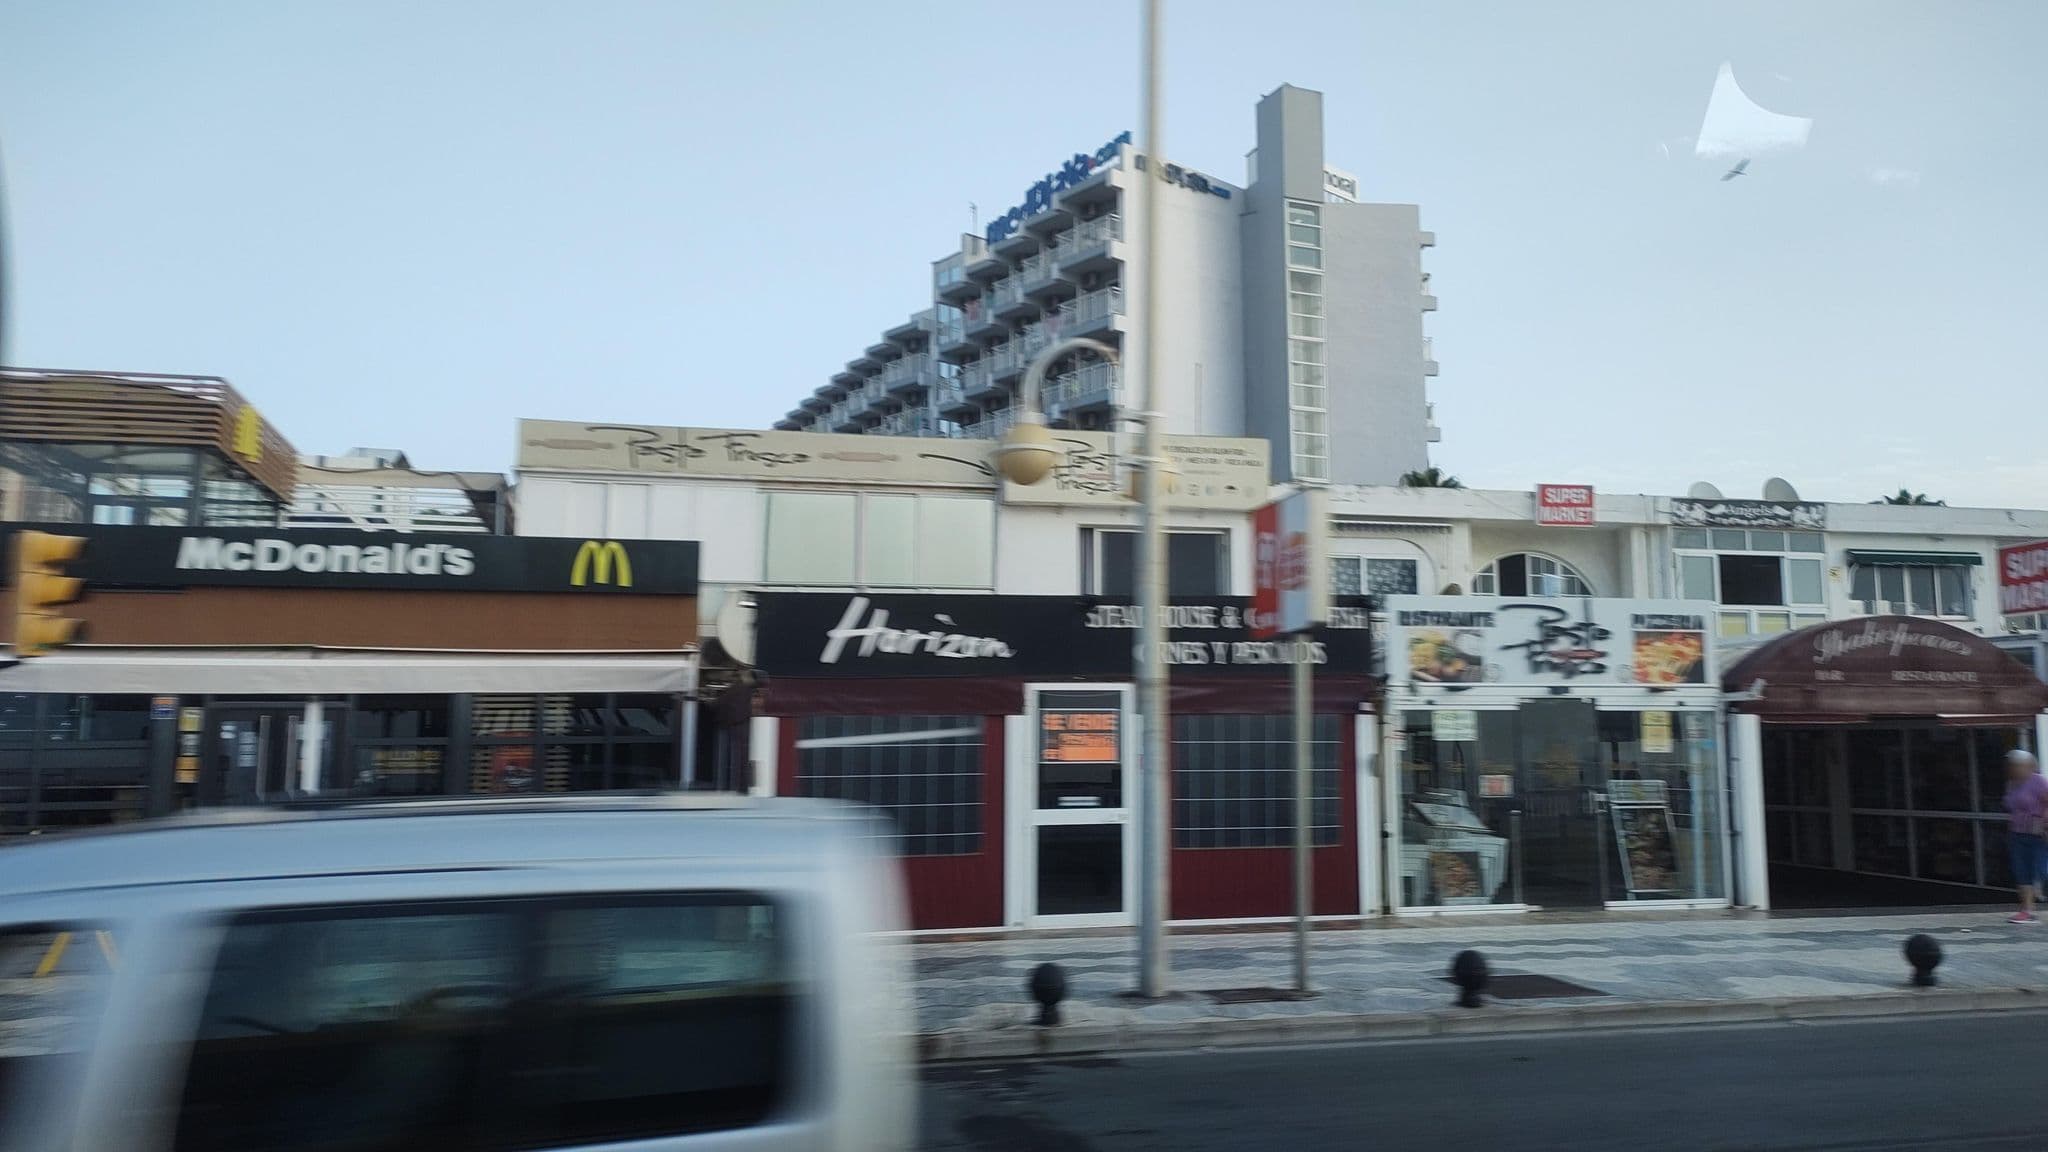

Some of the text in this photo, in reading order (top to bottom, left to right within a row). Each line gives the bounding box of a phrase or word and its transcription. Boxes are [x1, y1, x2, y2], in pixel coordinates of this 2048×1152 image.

[1543, 487, 1590, 505] SUPER
[1538, 505, 1593, 523] MARKET
[176, 536, 475, 576] McDonald's
